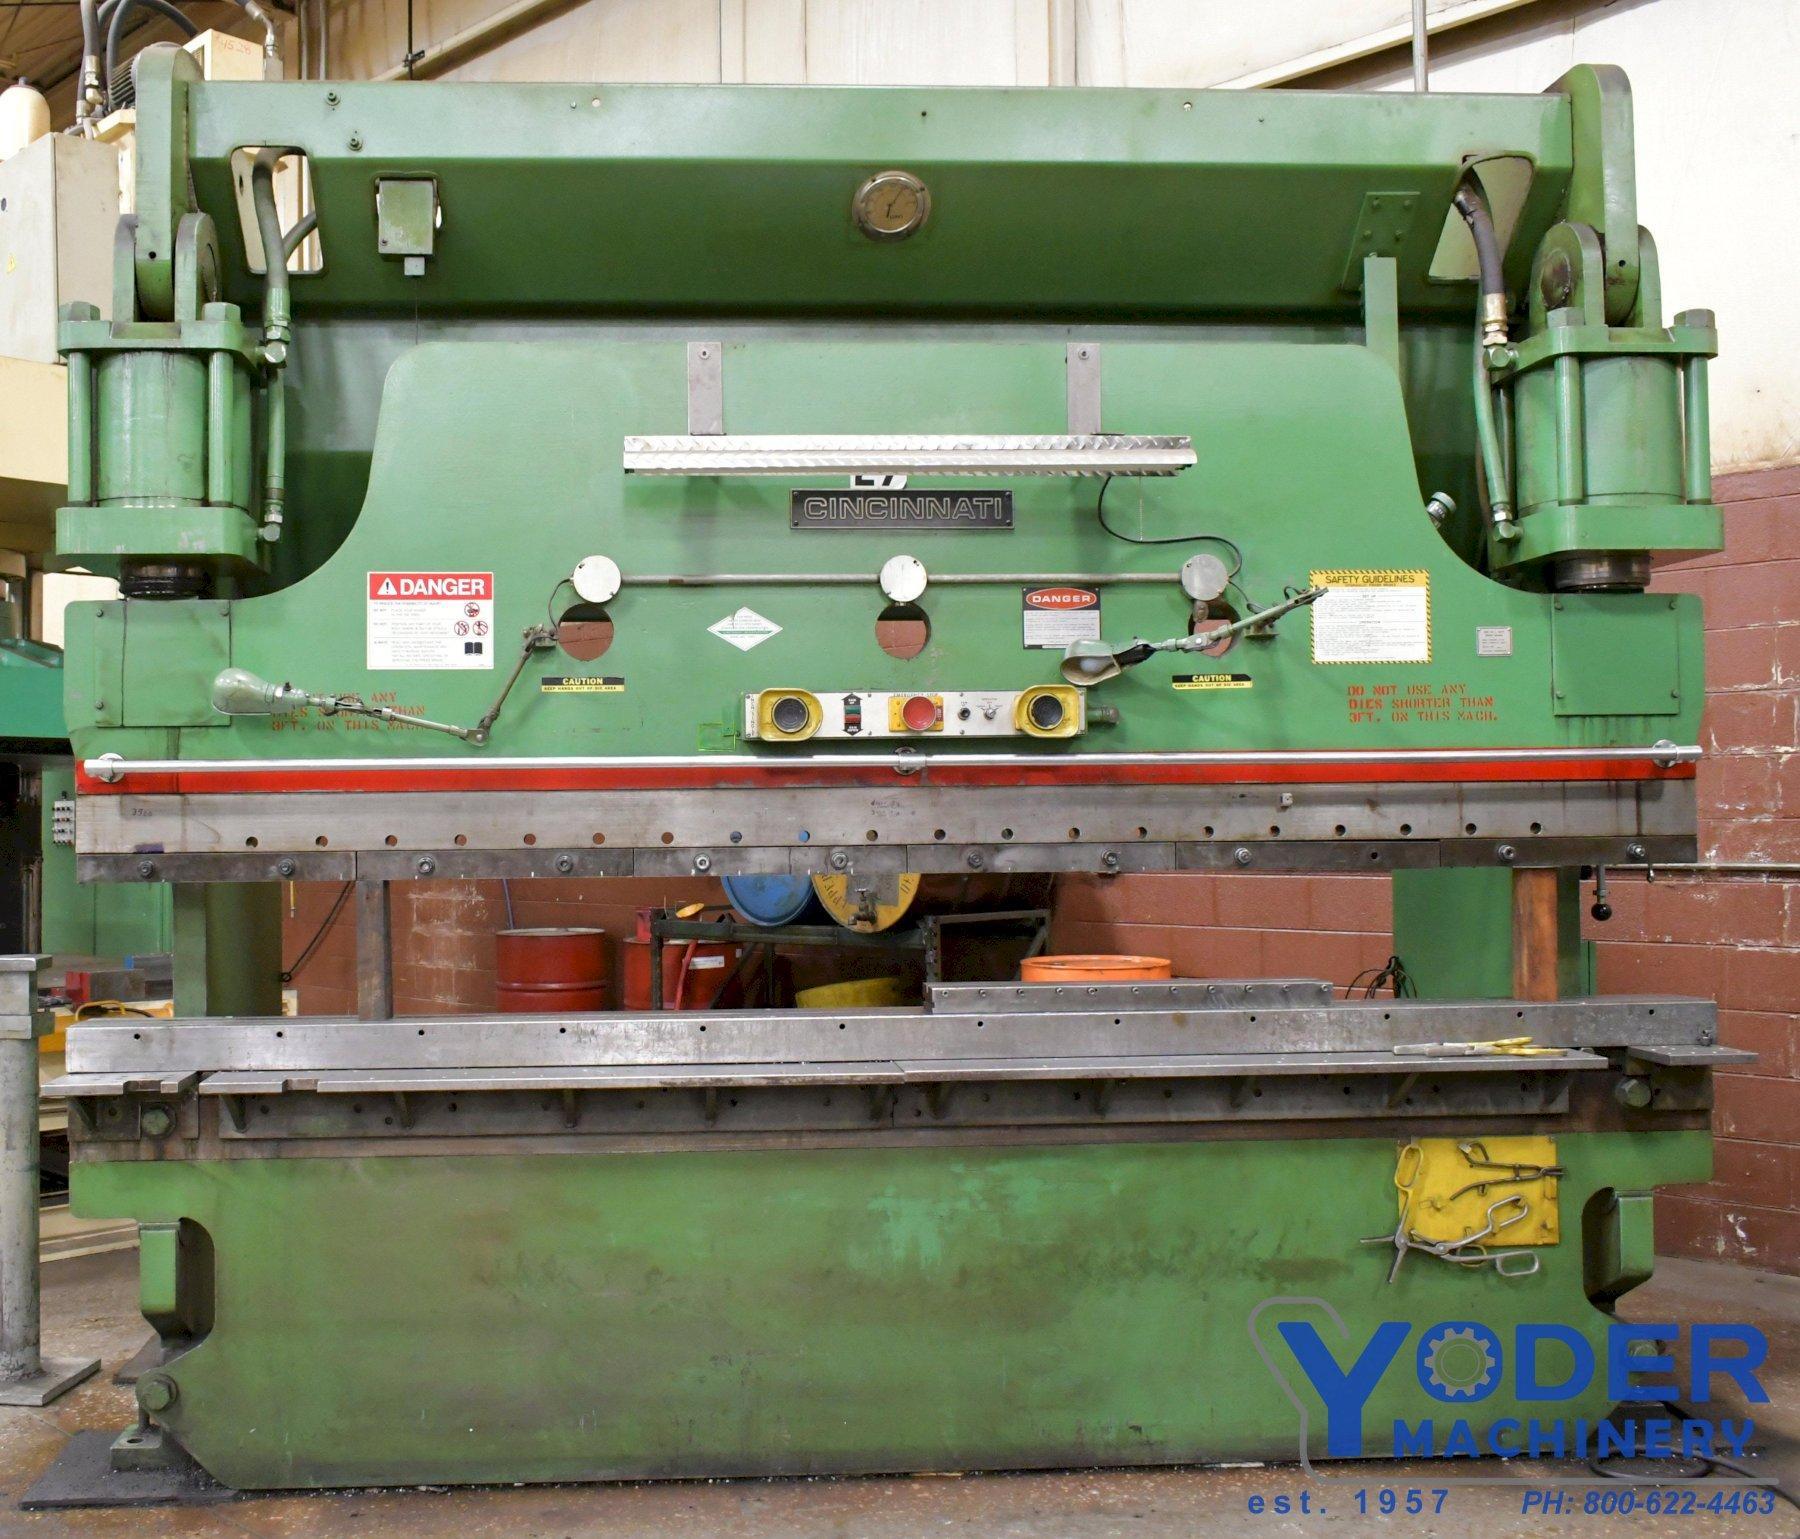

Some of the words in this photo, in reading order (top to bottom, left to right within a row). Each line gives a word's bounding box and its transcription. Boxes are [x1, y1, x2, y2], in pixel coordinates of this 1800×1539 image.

[804, 497, 1002, 520] CINCINNATI
[1325, 575, 1360, 584] SAFETY
[1362, 574, 1415, 583] GUIDELINES
[400, 578, 485, 595] DANGER
[1032, 595, 1091, 603] DANGER
[562, 677, 603, 685] CAUTION
[1192, 674, 1232, 682] CAUTION
[1347, 685, 1365, 696] DO
[1373, 685, 1397, 695] NOT
[1407, 684, 1432, 695] USE
[1442, 683, 1467, 694] ANY
[371, 692, 397, 702] ANY
[1349, 698, 1383, 709] DIES
[1391, 697, 1451, 709] SHORTER
[1460, 696, 1494, 707] THAN
[1391, 711, 1409, 722] ON
[1418, 710, 1450, 722] THIS
[318, 720, 334, 730] ON
[345, 720, 379, 731] THIS
